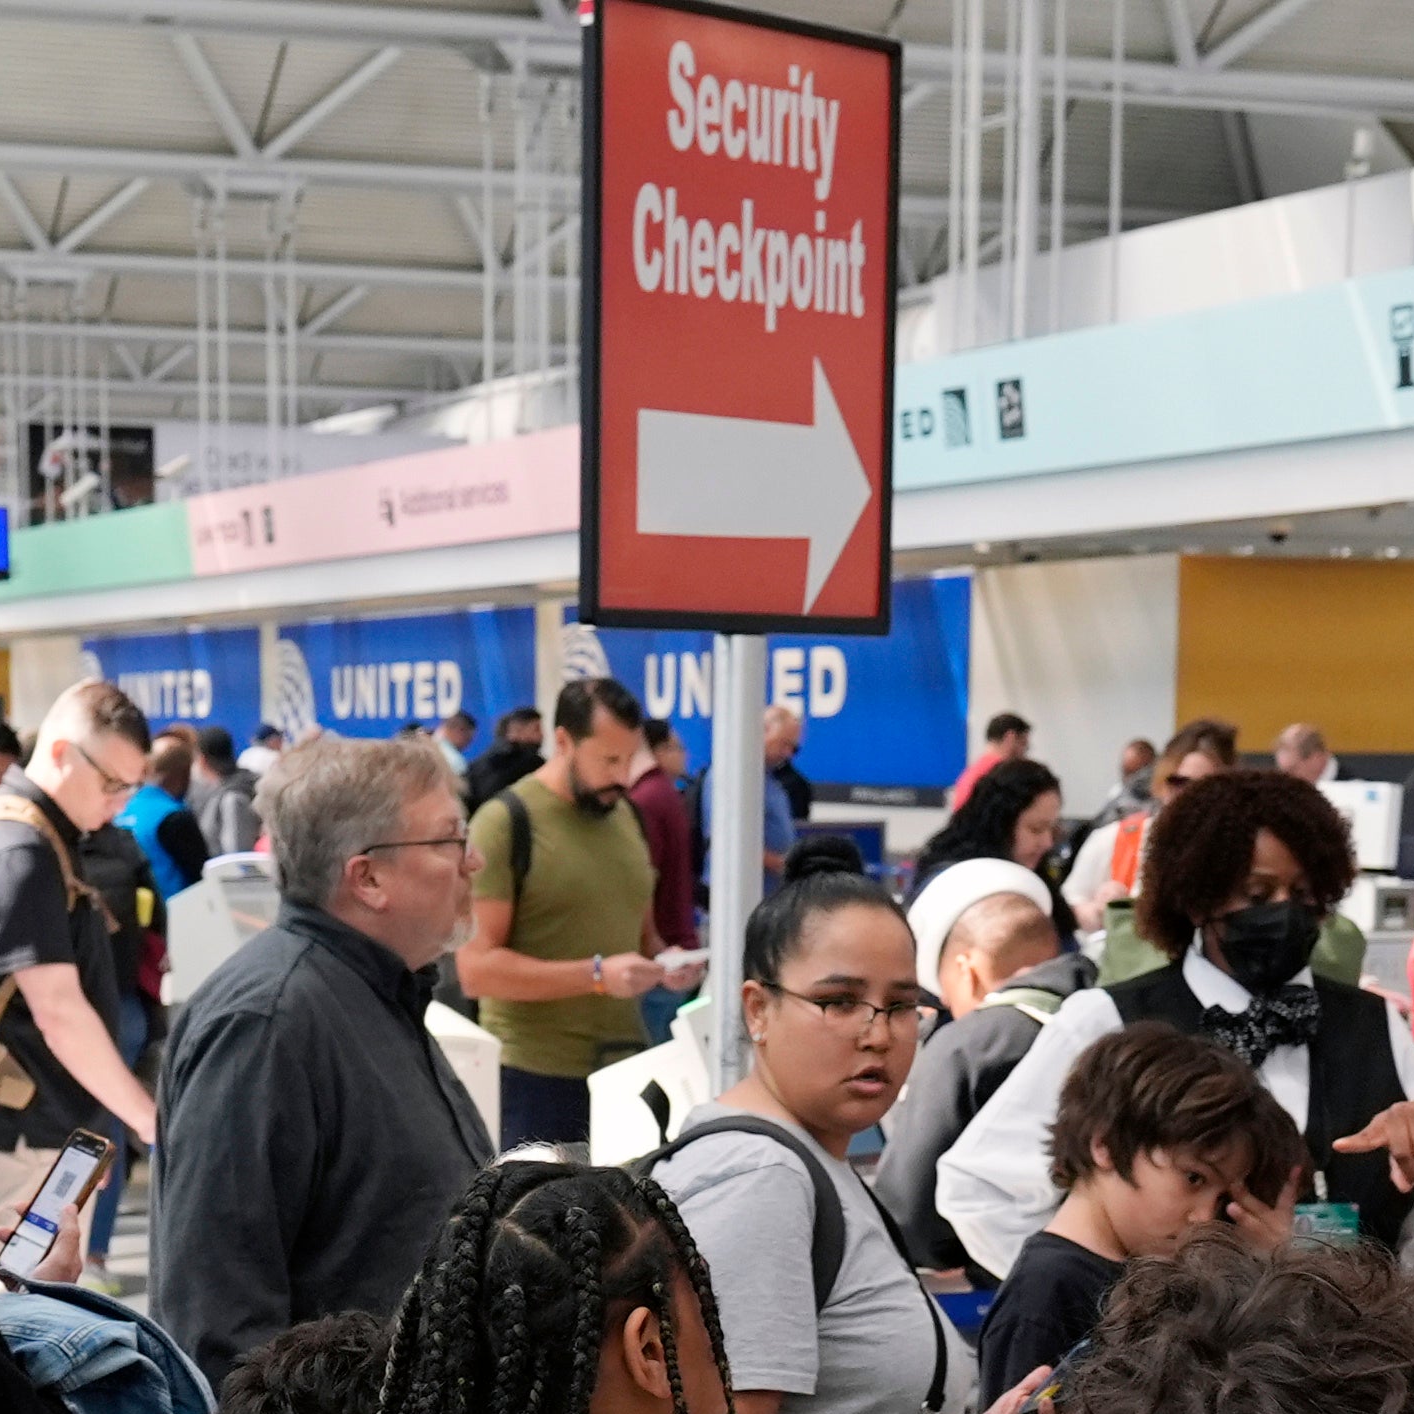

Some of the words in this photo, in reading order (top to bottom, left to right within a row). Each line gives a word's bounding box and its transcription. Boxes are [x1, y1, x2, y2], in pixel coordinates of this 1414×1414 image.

[667, 40, 840, 200] Security
[633, 182, 865, 332] Checkpoint
[331, 661, 463, 720] UNITED
[644, 646, 848, 720] UNED
